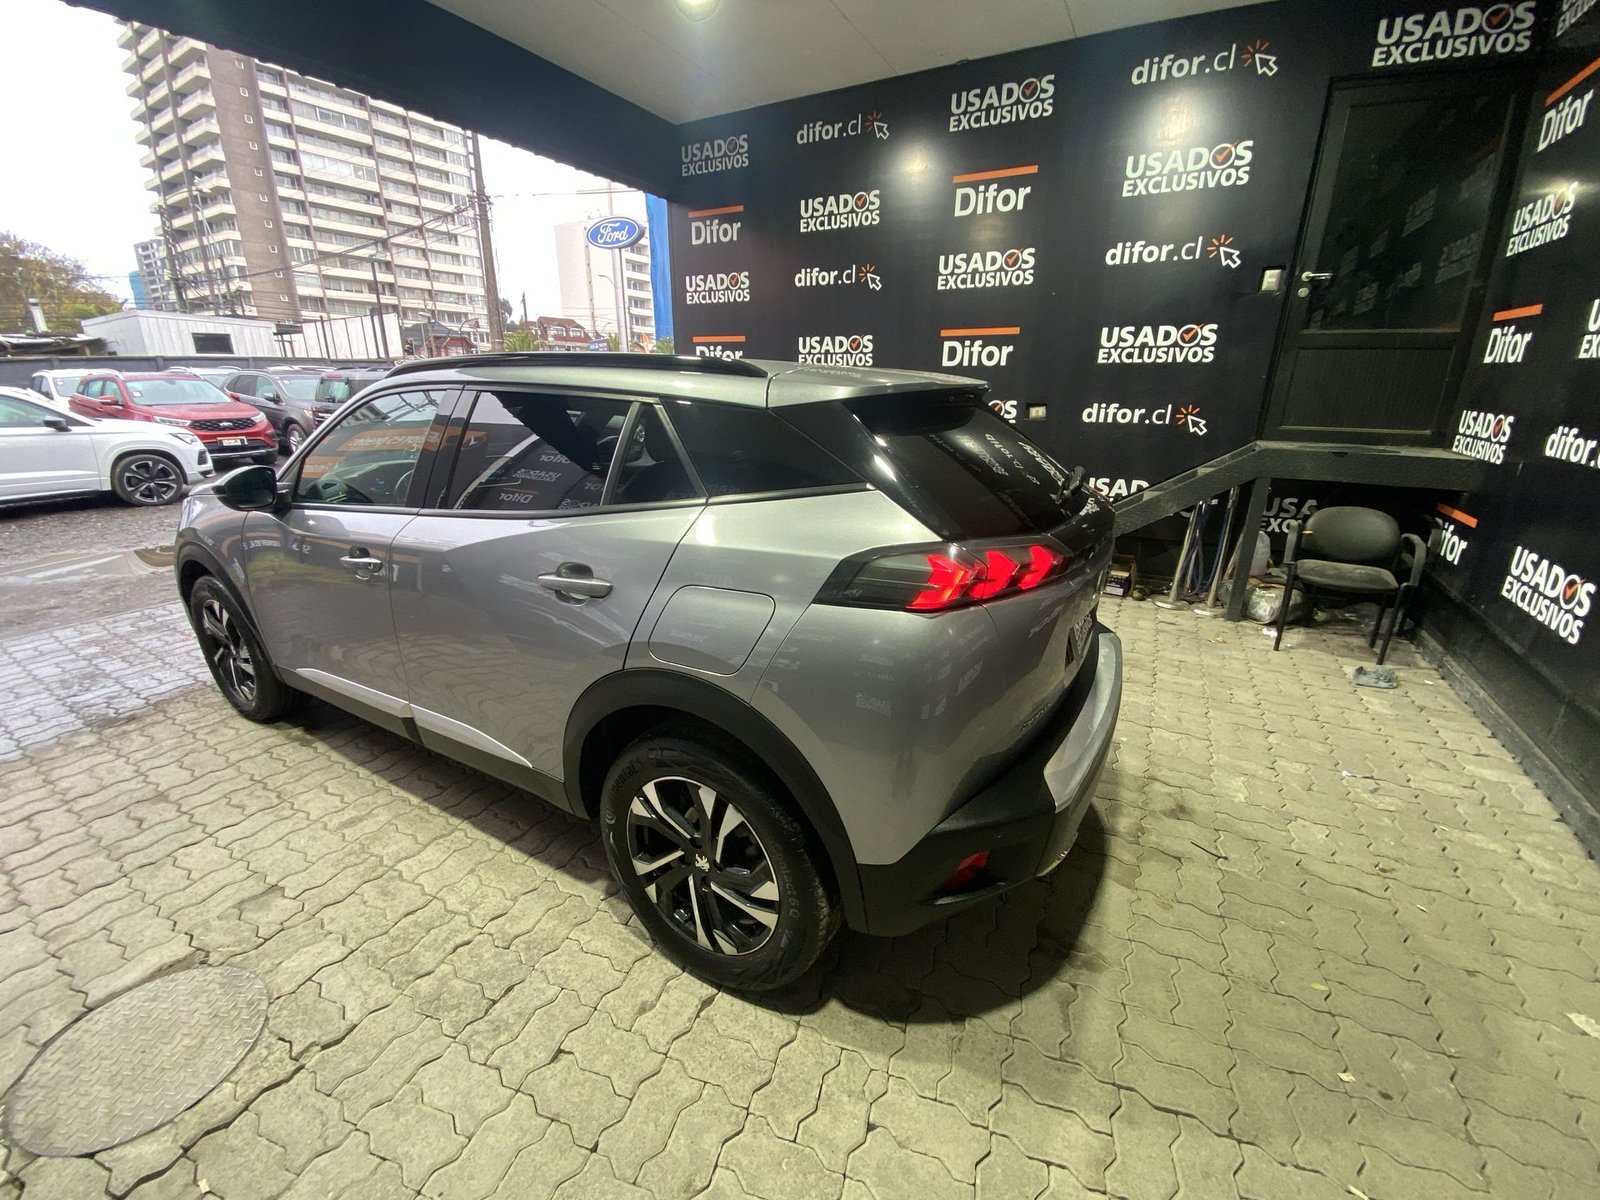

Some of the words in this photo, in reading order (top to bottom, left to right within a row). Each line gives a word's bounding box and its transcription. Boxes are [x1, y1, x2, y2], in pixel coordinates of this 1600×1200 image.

[1378, 1, 1535, 45] USADOS
[1372, 31, 1531, 67] EXCLUSIVOS
[1132, 44, 1236, 85] difor.cl
[951, 75, 1054, 115] USADOS
[797, 114, 861, 144] difor.cl
[950, 99, 1053, 132] EXCLUSIVOS
[1537, 89, 1593, 152] Difor
[681, 134, 748, 162] USADOS
[1126, 141, 1253, 180] USADOS
[682, 154, 748, 176] EXCLUSIVOS
[1122, 167, 1250, 197] EXCLUSIVOS
[801, 190, 880, 217] USADOS
[955, 185, 1031, 217] Difor
[1512, 182, 1578, 235] USADOS
[597, 222, 629, 244] Ford
[691, 219, 740, 245] Difor
[801, 211, 880, 232] EXCLUSIVOS
[1506, 215, 1571, 257] EXCLUSIVOS
[938, 248, 1035, 275] USADOS
[1106, 236, 1202, 265] difor.cl
[686, 272, 749, 291] USADOS
[795, 265, 855, 287] difor.cl
[938, 269, 1033, 290] EXCLUSIVOS
[687, 289, 750, 304] EXCLUSIVOS
[799, 335, 873, 354] USADOS
[1101, 324, 1218, 347] USADOS
[1483, 326, 1532, 363] Difor
[798, 353, 873, 366] EXCLUSIVOS
[942, 340, 1013, 366] Difor
[1098, 347, 1214, 363] EXCLUSIVOS
[1082, 403, 1172, 424] difor.cl
[1459, 410, 1514, 443] USADOS
[1452, 435, 1506, 465] EXCLUSIVOS
[1545, 426, 1600, 468] difor.
[1440, 522, 1467, 565] ifor
[1509, 546, 1597, 617] USADOS
[1501, 576, 1585, 644] EXCLUSIVOS
